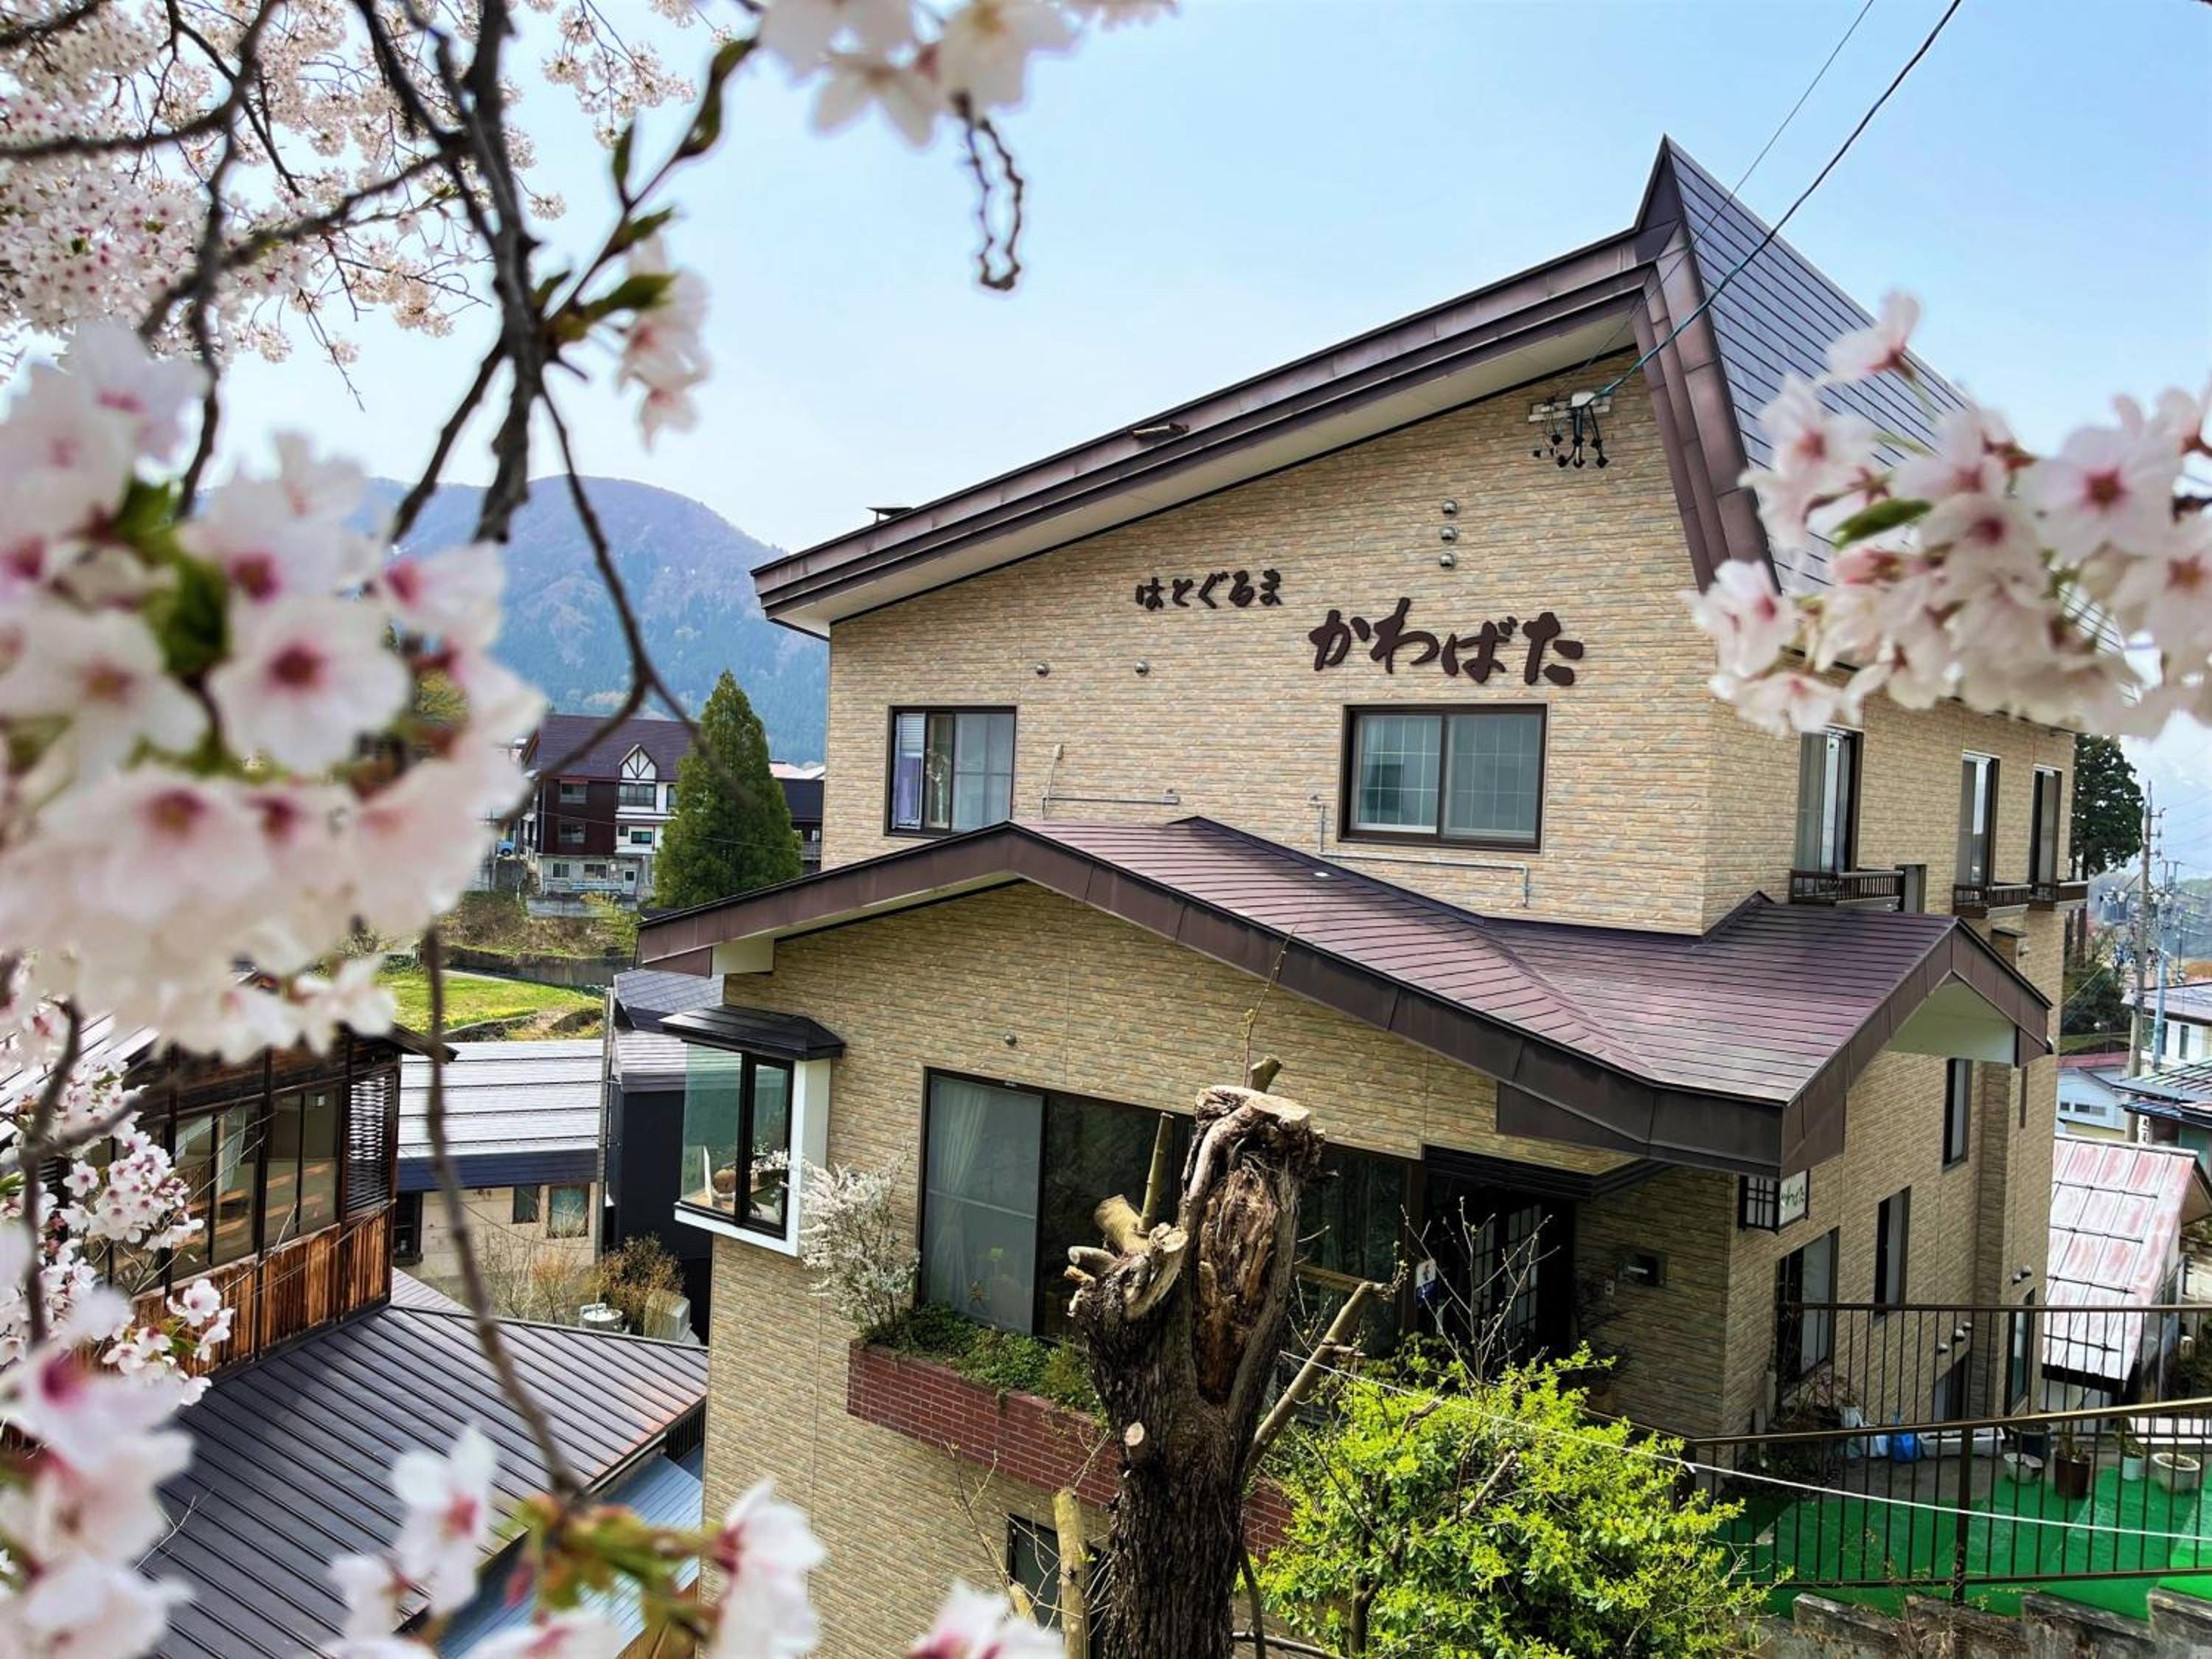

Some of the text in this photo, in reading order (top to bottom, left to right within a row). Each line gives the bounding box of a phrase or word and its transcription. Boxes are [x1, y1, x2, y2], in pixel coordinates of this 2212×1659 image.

[1135, 568, 1283, 611] はとぐるま
[1308, 597, 1584, 686] かわばた
